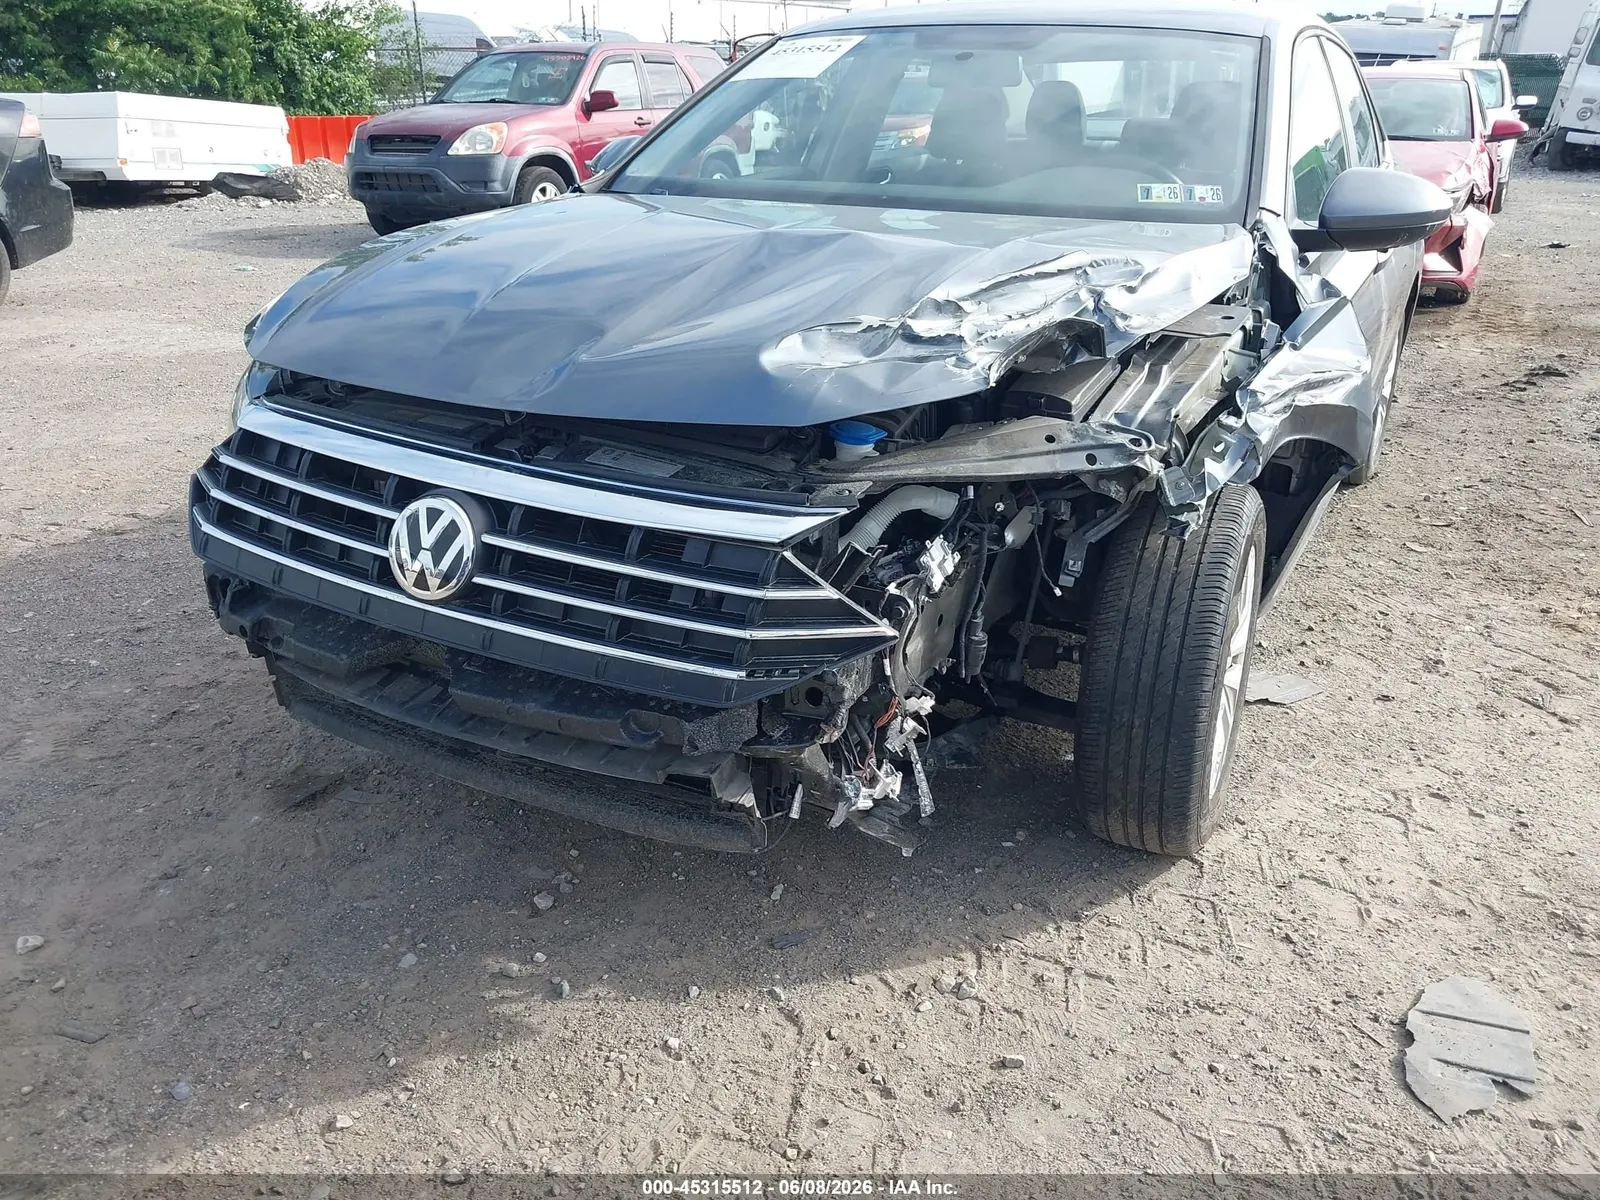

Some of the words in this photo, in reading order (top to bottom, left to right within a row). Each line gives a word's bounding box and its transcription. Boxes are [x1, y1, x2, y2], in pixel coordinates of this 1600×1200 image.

[1143, 188, 1150, 200] 7
[1167, 187, 1178, 199] 26
[1210, 188, 1221, 200] 26
